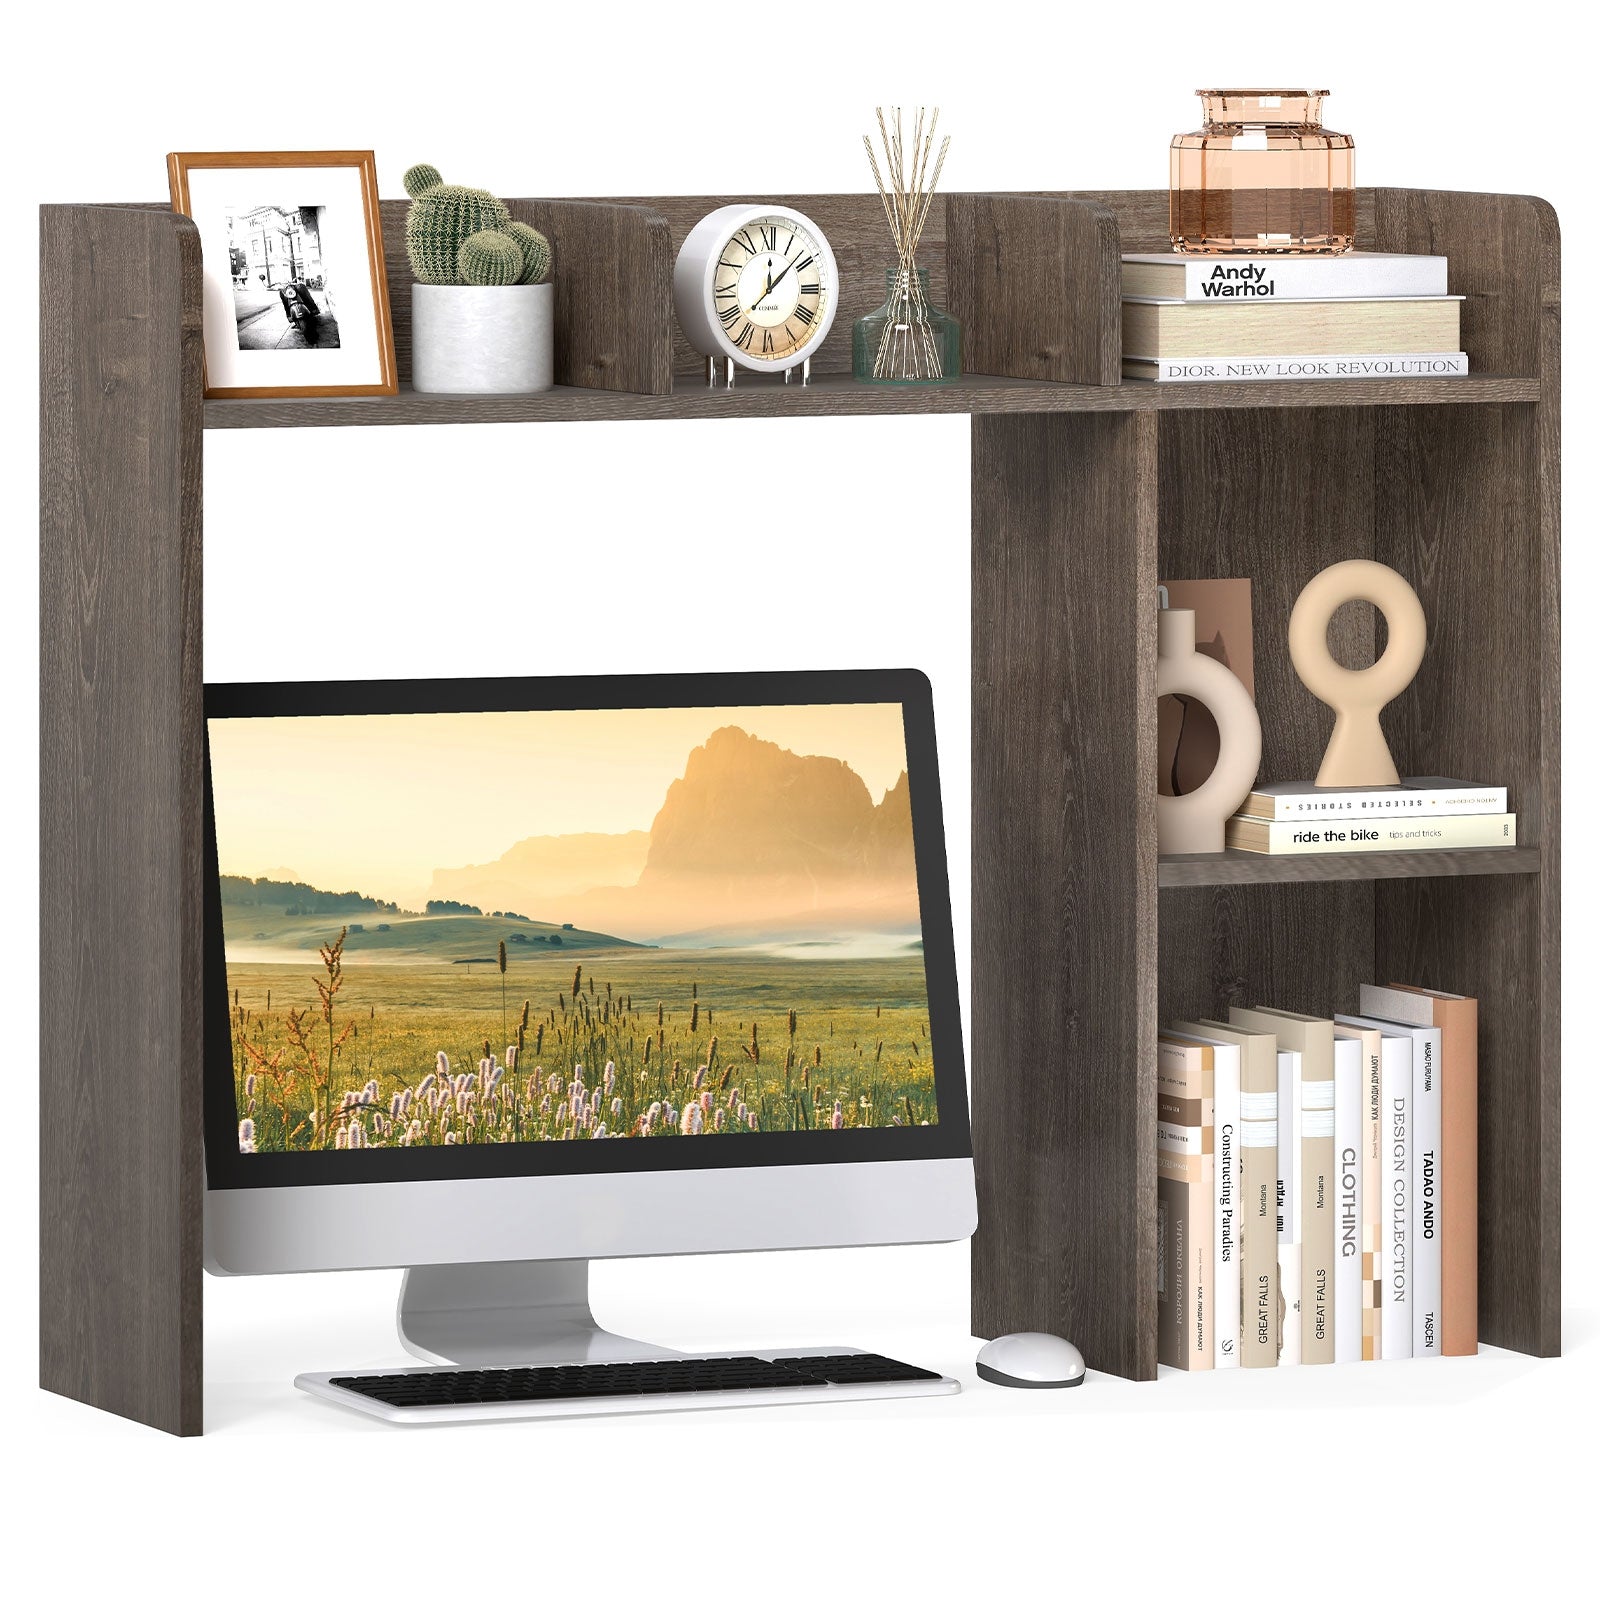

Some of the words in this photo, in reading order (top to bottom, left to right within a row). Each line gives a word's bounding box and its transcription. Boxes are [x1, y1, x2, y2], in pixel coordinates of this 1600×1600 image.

[800, 284, 819, 295] III
[1201, 280, 1275, 297] Warhol
[1210, 263, 1266, 283] Andy
[1168, 365, 1220, 378] DIOR.
[1226, 364, 1270, 376] NEW
[1276, 362, 1330, 375] LOOK
[1336, 359, 1460, 374] REVOLUTION
[1298, 802, 1352, 811] STORIES
[1361, 799, 1423, 809] SELECTED
[1293, 831, 1320, 843] ride
[1323, 830, 1347, 842] the
[1350, 829, 1379, 841] bike
[1389, 830, 1404, 840] tips
[1404, 829, 1421, 838] and
[1421, 829, 1442, 838] tricks
[1424, 1041, 1432, 1062] MASAO
[1371, 1054, 1380, 1085] ДУМАЮТ
[1371, 1084, 1380, 1106] ЛЮДИ
[1371, 1106, 1379, 1121] КАК
[1393, 1097, 1406, 1172] DESIGN
[1220, 1124, 1234, 1206] Constructing
[1423, 1150, 1434, 1198] TADAO
[1259, 1184, 1267, 1217] Montana
[1316, 1175, 1324, 1209] Montana
[1342, 1147, 1357, 1258] CLOTHING
[1221, 1209, 1234, 1262] Paradies
[1423, 1201, 1434, 1240] ANDO
[1393, 1179, 1406, 1303] COLLECTION
[1258, 1275, 1269, 1307] FALLS
[1315, 1268, 1326, 1301] FALLS
[1258, 1308, 1269, 1344] GREAT
[1315, 1302, 1326, 1340] GREAT
[1424, 1311, 1434, 1348] TASCEN
